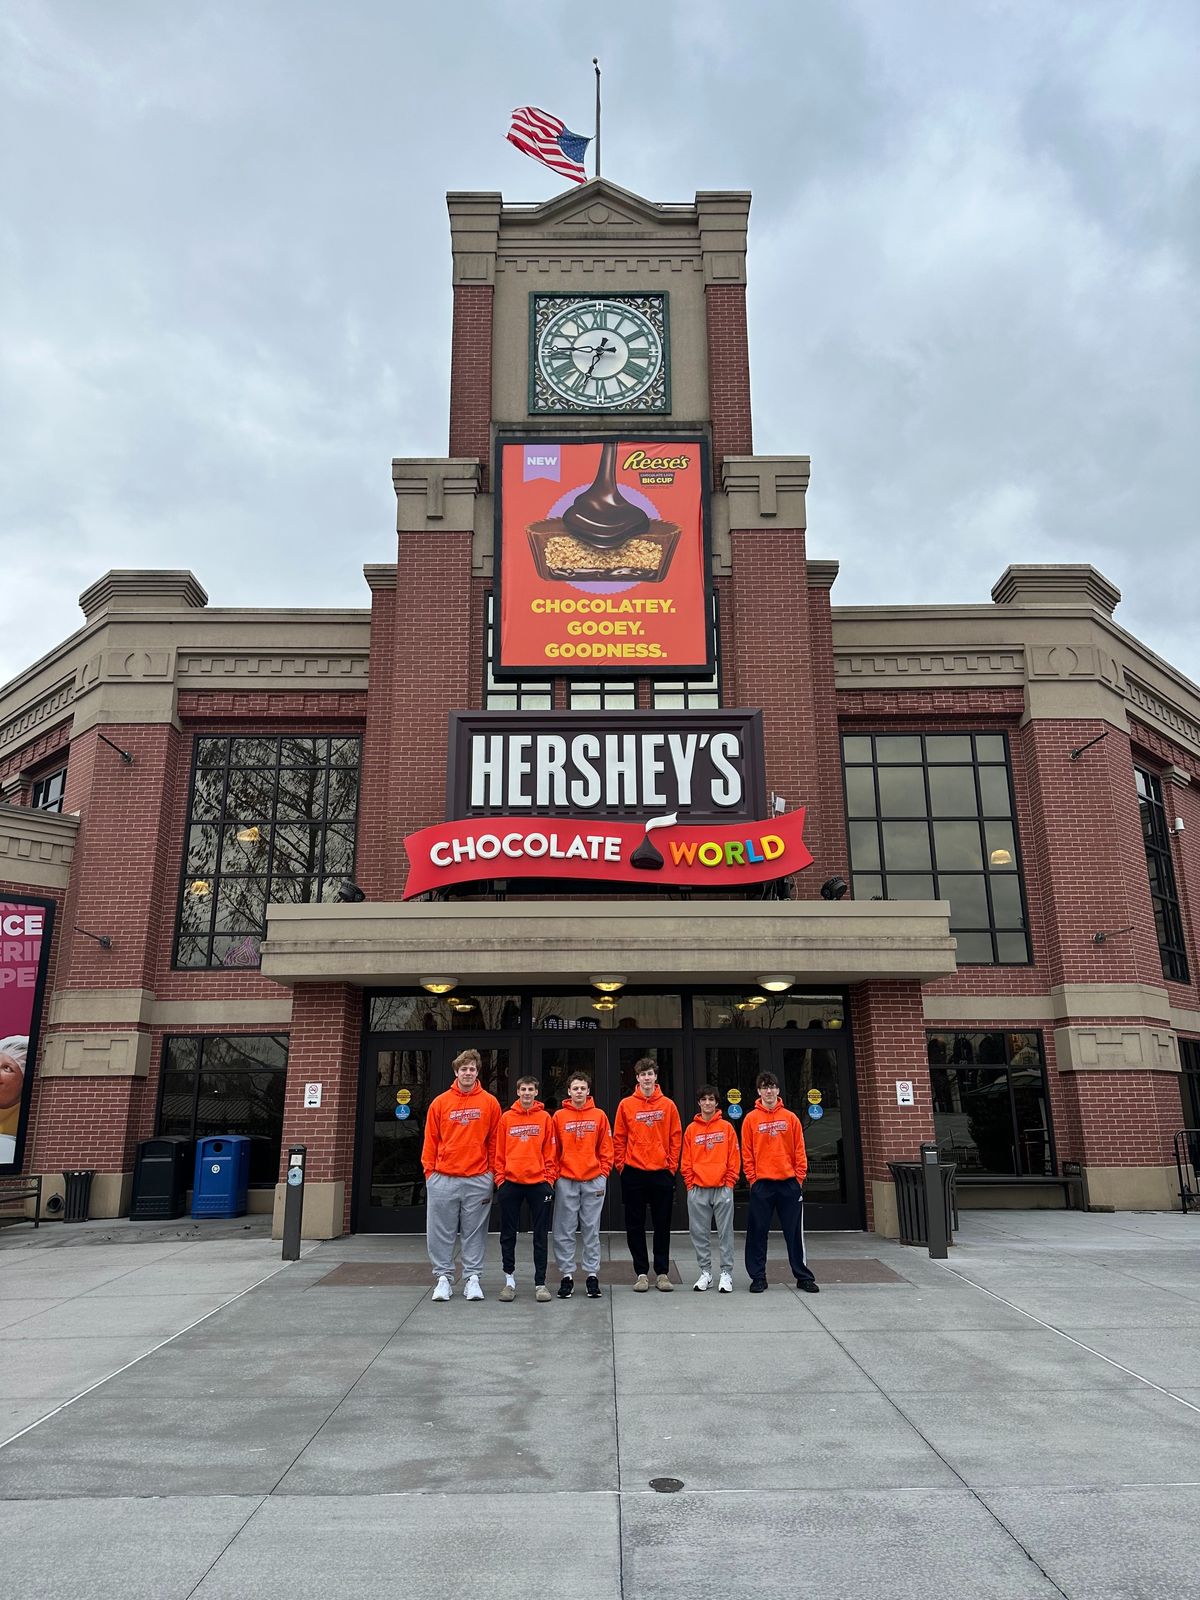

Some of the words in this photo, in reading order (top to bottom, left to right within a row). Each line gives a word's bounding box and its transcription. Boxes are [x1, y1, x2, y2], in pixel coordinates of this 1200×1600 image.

[527, 456, 557, 466] NEW
[623, 450, 691, 470] Reese's
[531, 599, 676, 613] CHOCOLATEY.
[567, 621, 645, 635] GOOEY.
[544, 643, 668, 658] GOODNESS.
[471, 733, 742, 808] HERSHEY'S
[429, 832, 622, 867] CHOCOLATE
[669, 834, 786, 867] WORLD
